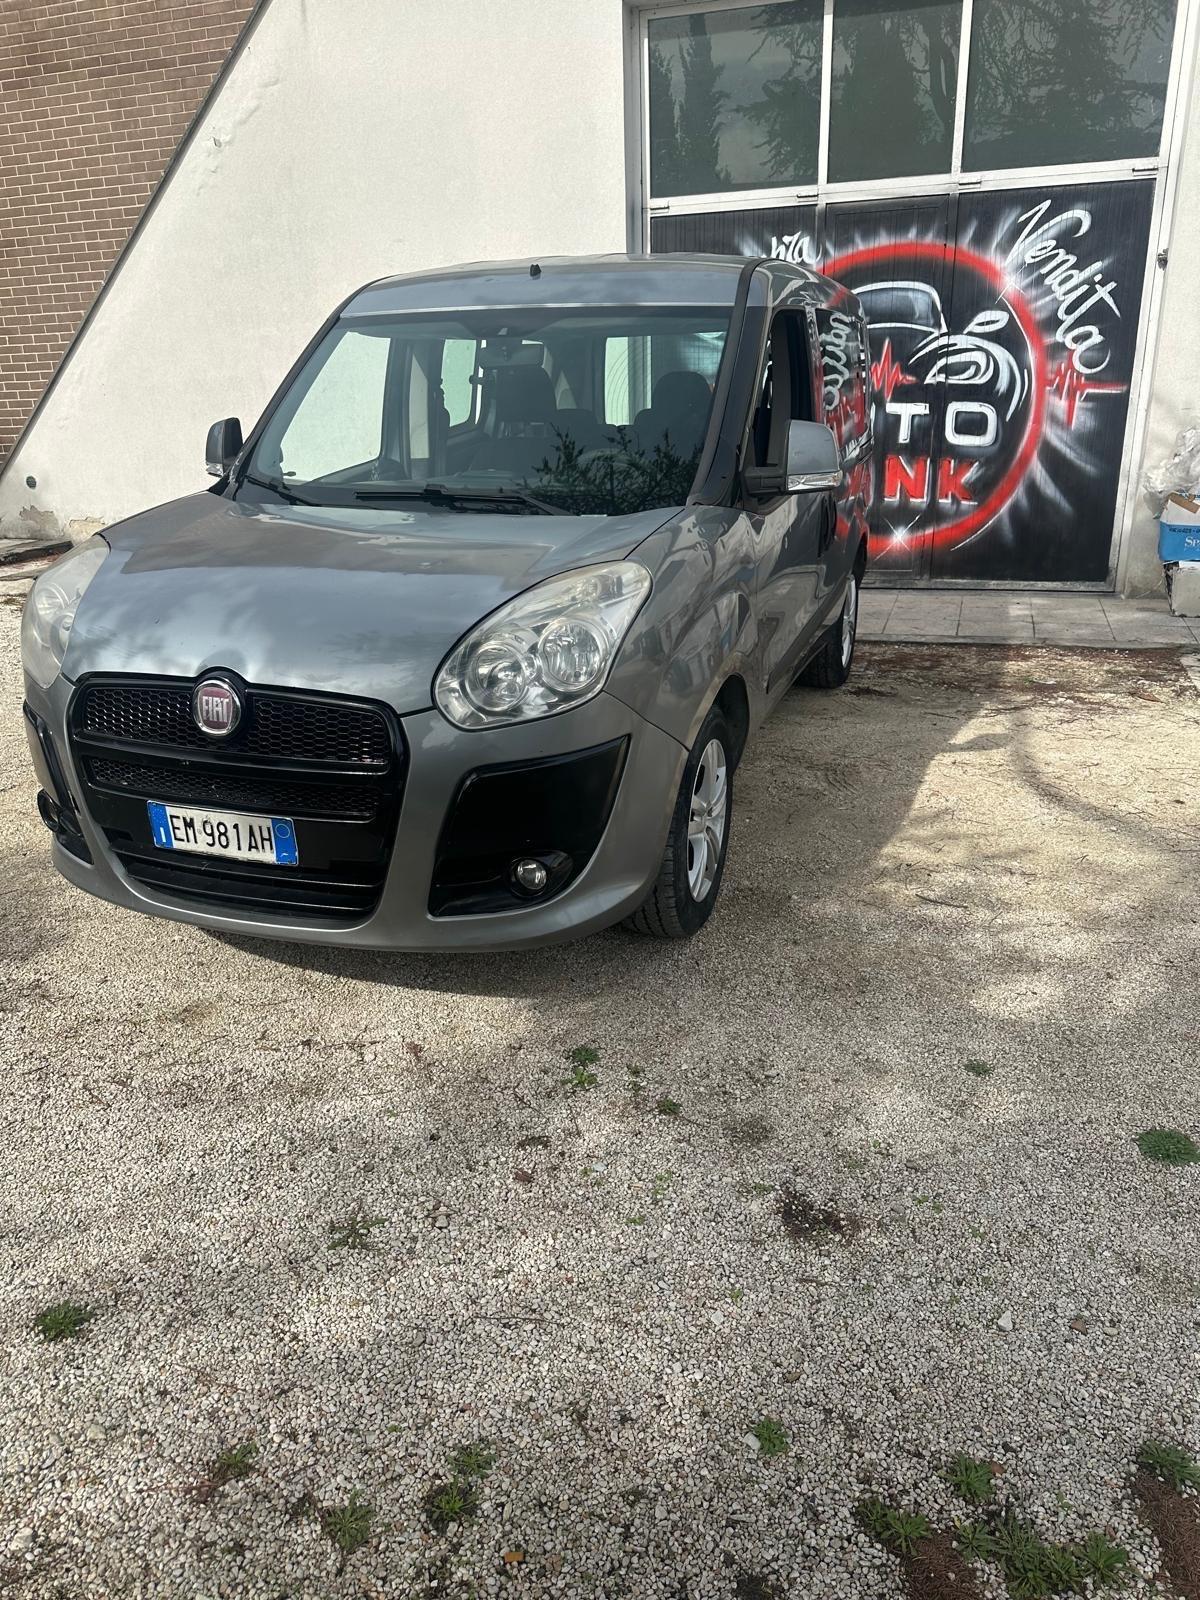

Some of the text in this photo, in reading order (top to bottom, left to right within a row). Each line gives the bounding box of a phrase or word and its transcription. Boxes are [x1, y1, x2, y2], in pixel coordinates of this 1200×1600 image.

[764, 231, 822, 264] nza
[1005, 200, 1121, 374] Vendita
[870, 401, 997, 446] TO
[202, 695, 229, 723] FIAT
